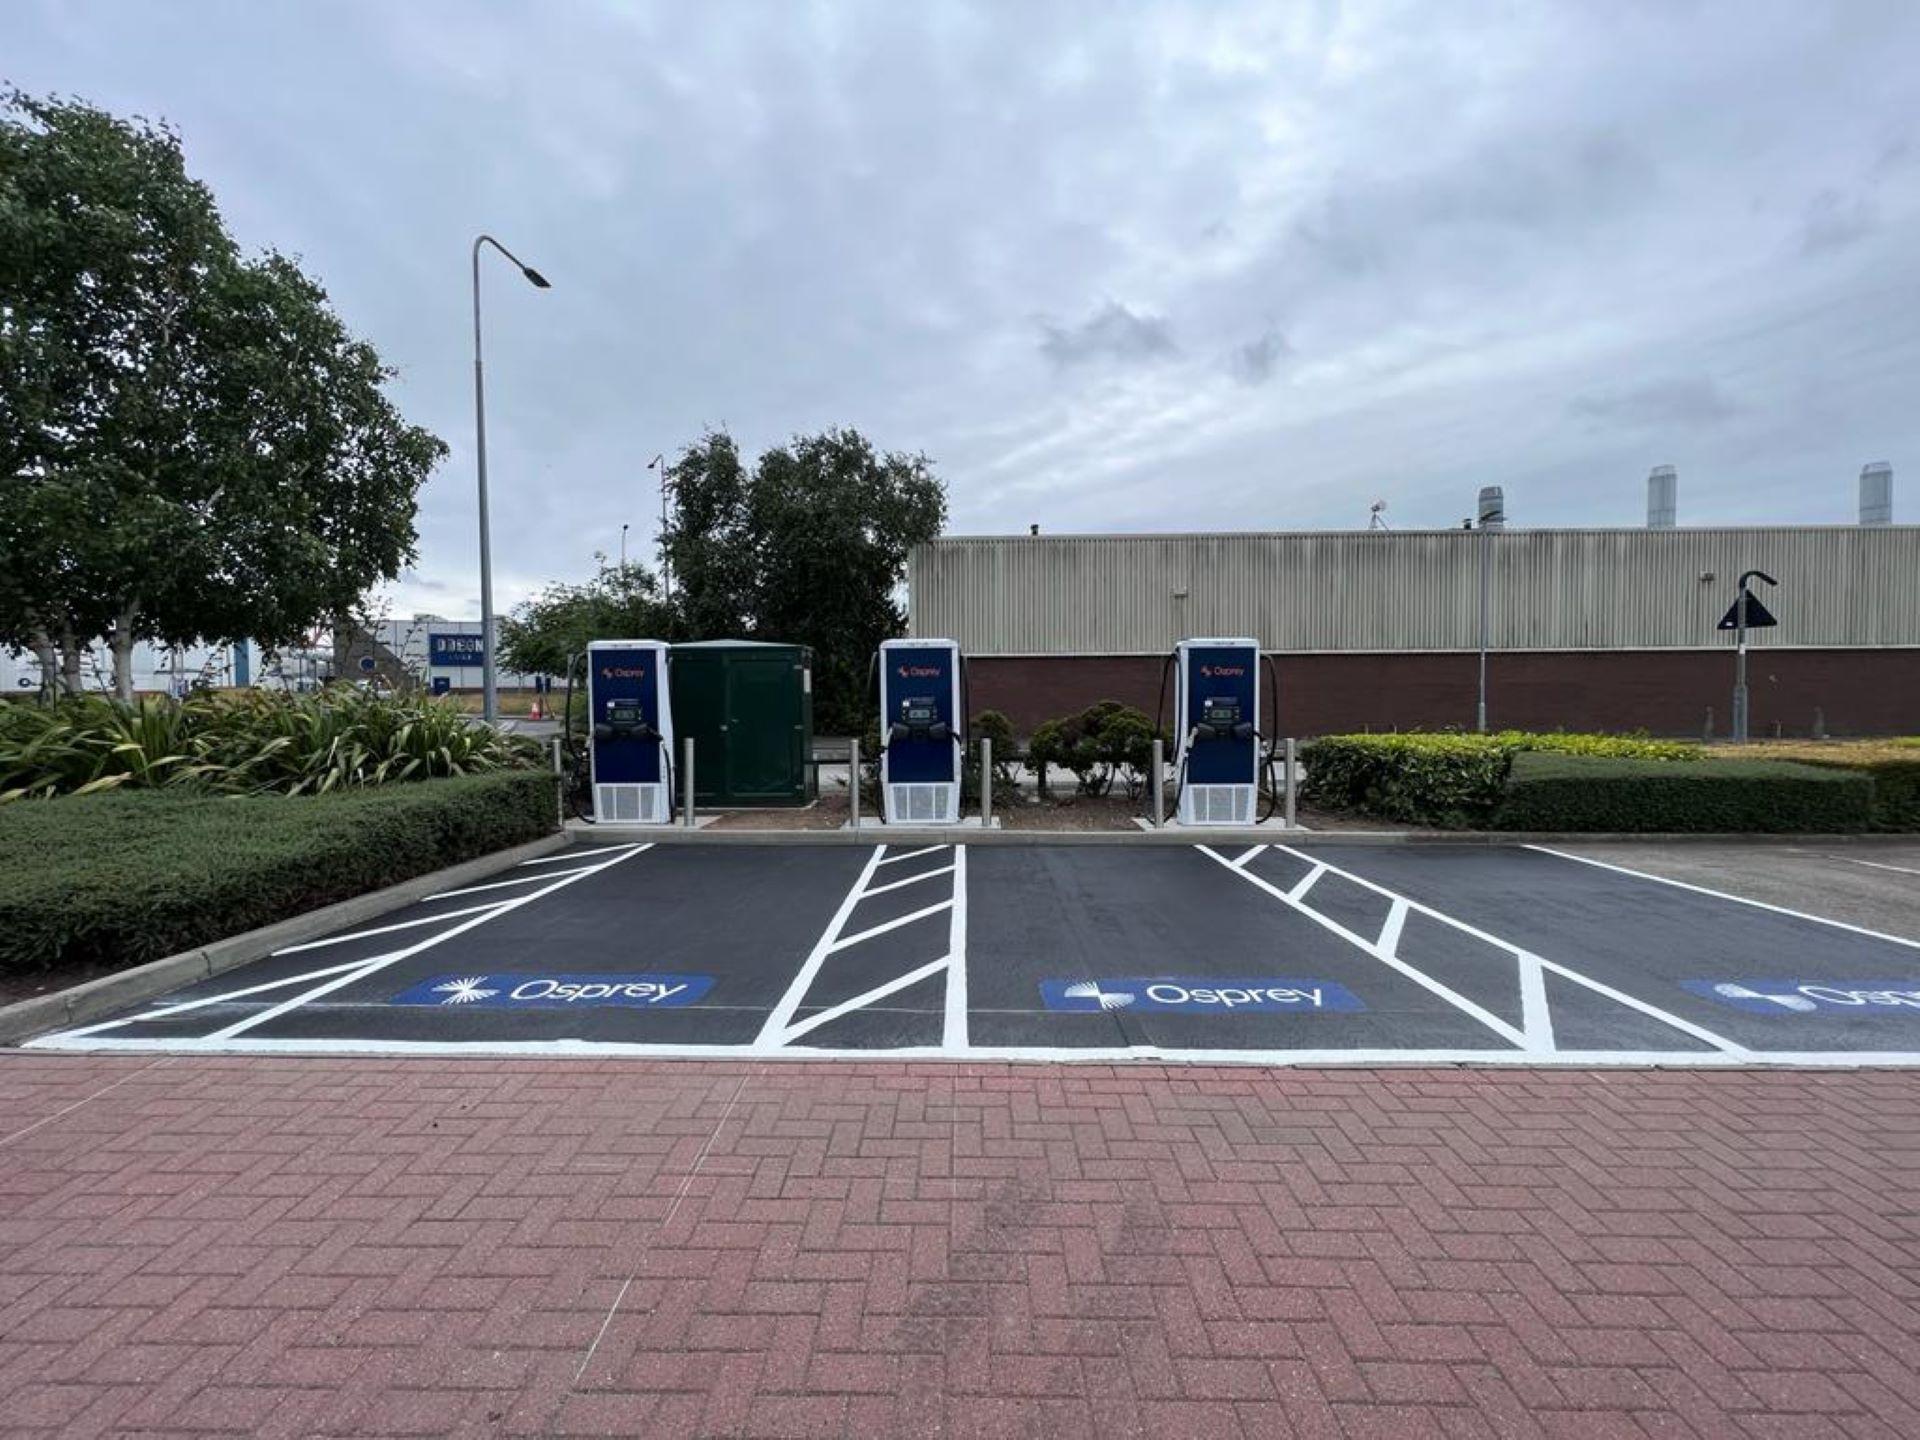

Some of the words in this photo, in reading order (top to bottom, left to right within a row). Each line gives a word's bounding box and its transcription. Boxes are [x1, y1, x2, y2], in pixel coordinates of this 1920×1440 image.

[614, 667, 644, 680] Osprey
[1214, 666, 1245, 678] Osprey
[510, 978, 688, 1002] Osprey
[1146, 984, 1323, 1008] Osprey
